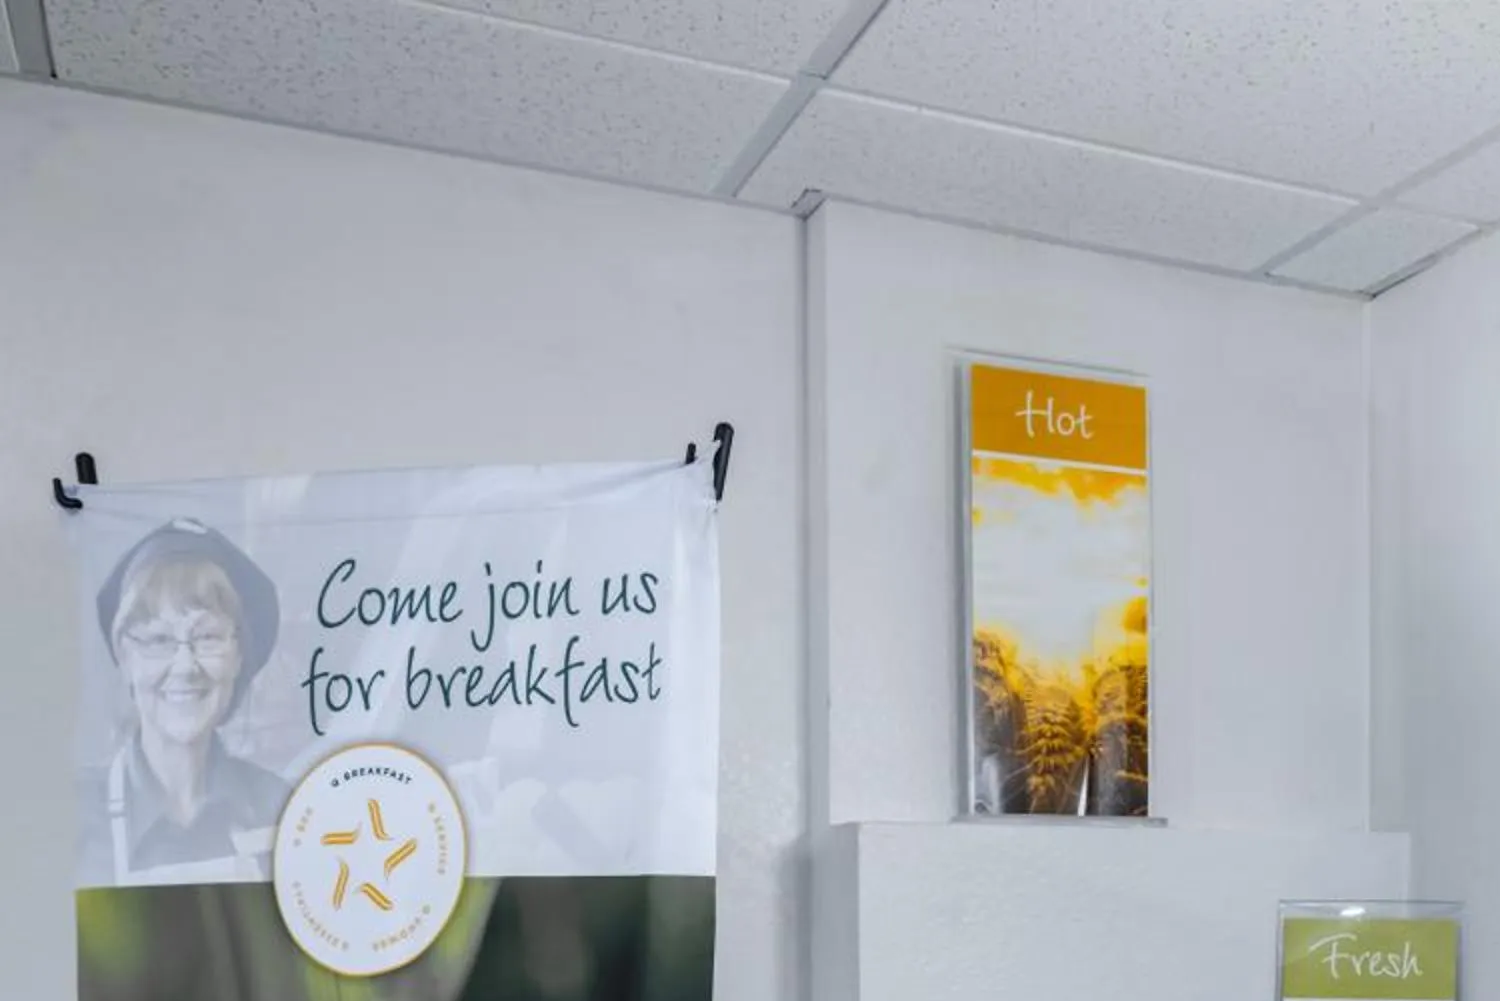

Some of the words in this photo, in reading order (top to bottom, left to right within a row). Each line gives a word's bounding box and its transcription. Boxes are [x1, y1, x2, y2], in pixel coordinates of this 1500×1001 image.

[1014, 389, 1094, 440] Hot
[315, 557, 464, 630] Come
[469, 558, 581, 652] join
[600, 568, 660, 617] us
[300, 646, 386, 736] for
[403, 635, 663, 728] breakfast
[343, 766, 413, 785] BREAKFAST
[1308, 933, 1424, 980] Fresh
